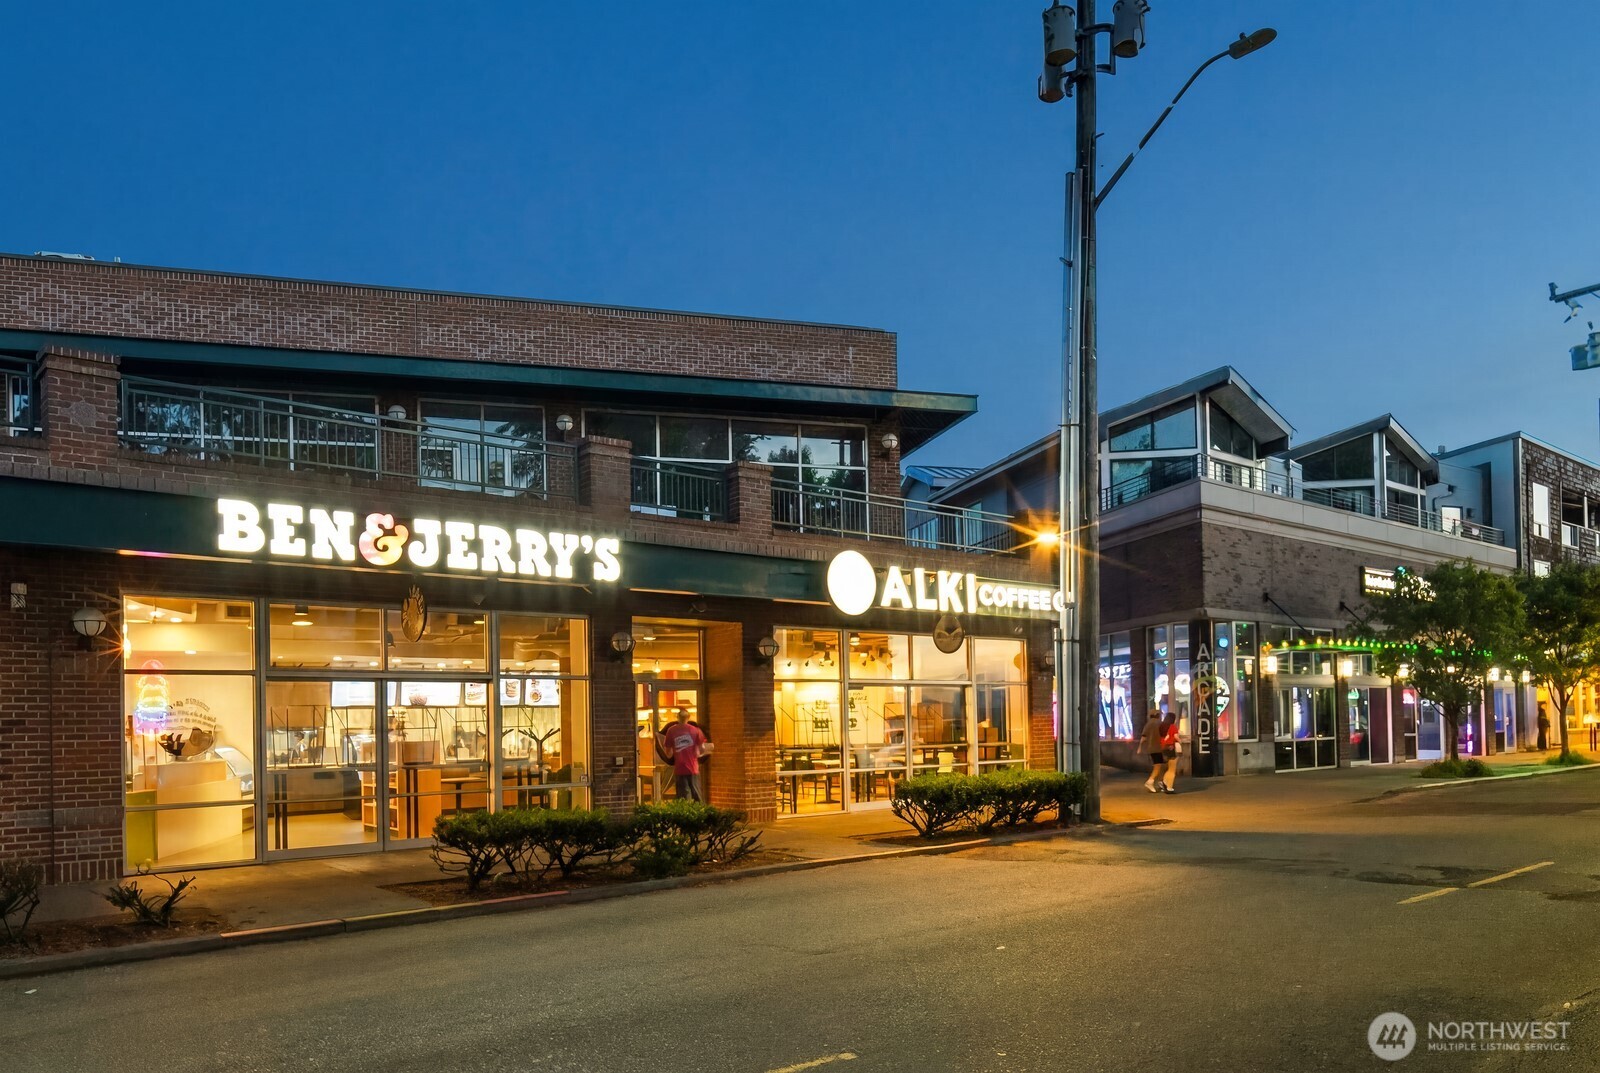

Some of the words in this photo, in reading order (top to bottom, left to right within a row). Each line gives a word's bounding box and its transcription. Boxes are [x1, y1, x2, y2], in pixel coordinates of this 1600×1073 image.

[879, 565, 978, 615] ALKI
[978, 584, 1052, 611] COFFEE
[1196, 643, 1211, 754] ARCADE
